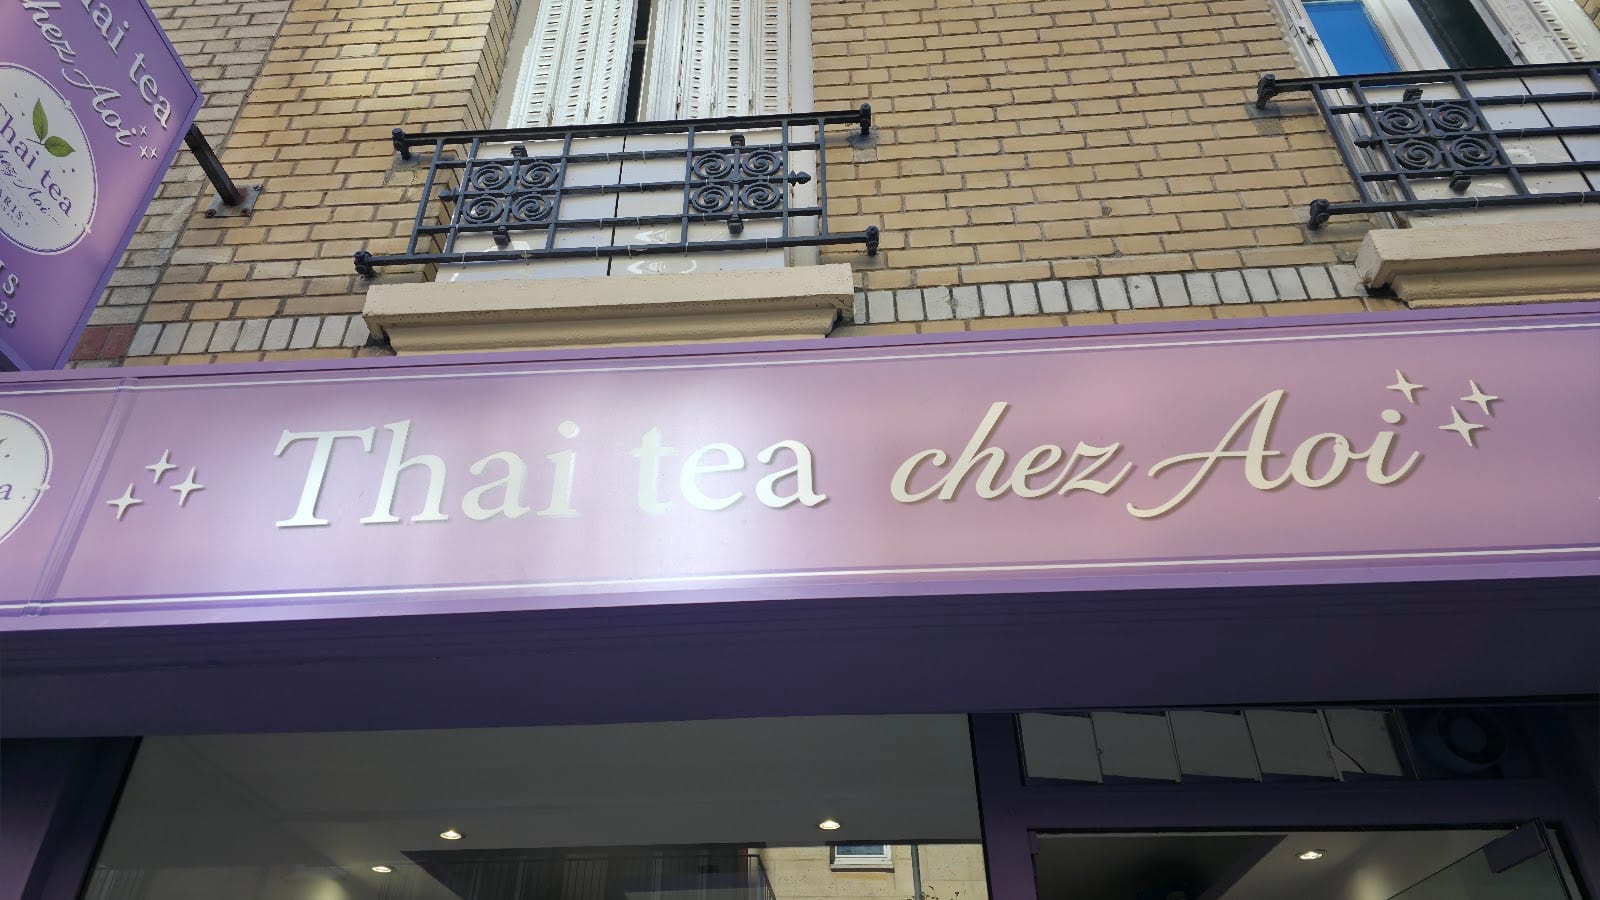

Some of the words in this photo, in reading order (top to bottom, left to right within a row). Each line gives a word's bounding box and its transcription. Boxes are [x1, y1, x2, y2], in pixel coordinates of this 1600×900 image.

[22, 0, 77, 63] hez
[61, 67, 137, 147] Aoi
[80, 0, 129, 55] ai
[129, 52, 172, 131] tea
[41, 169, 70, 217] tea
[273, 419, 581, 528] Thai
[630, 426, 828, 514] tea
[889, 400, 1133, 504] chez
[1125, 388, 1422, 519] Aoi
